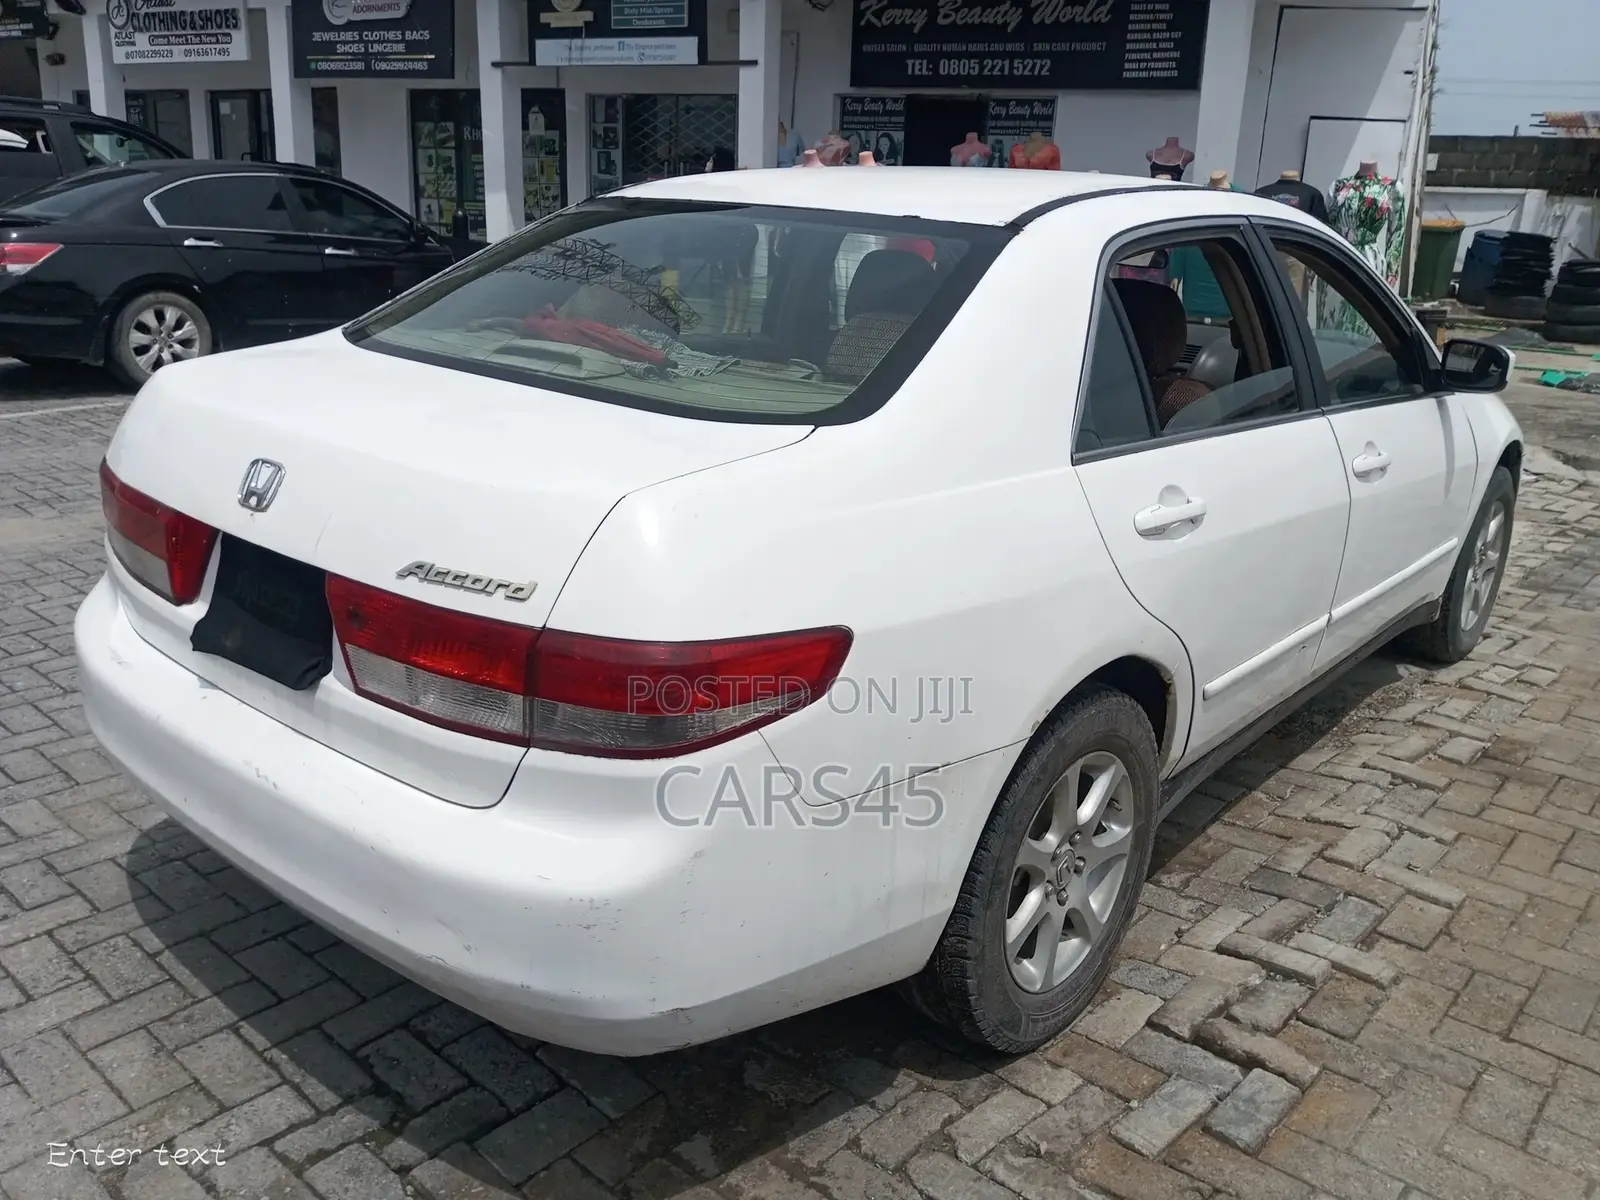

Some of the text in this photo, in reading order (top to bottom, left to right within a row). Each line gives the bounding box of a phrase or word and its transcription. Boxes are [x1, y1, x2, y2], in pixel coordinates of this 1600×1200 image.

[352, 3, 400, 14] ADORNMENTS
[859, 0, 1112, 34] Kerry Beauty World
[150, 33, 231, 45] Come Meet The New You
[312, 31, 359, 41] JEWELRIES
[363, 31, 402, 40] CLOTHES
[336, 44, 405, 53] SHOES LINGERIE
[914, 43, 940, 52] QUALITY
[942, 43, 967, 52] HUMAN
[1005, 42, 1025, 51] WIGS
[1033, 42, 1051, 51] SKIN
[1052, 42, 1070, 51] CARE
[1071, 41, 1106, 51] PRODUCT
[184, 48, 230, 57] 09163617495
[906, 59, 1051, 76] TEL: 0805 221 5272
[989, 100, 1006, 118] Kerry
[1009, 100, 1031, 118] Beauty
[396, 561, 538, 601] Accord
